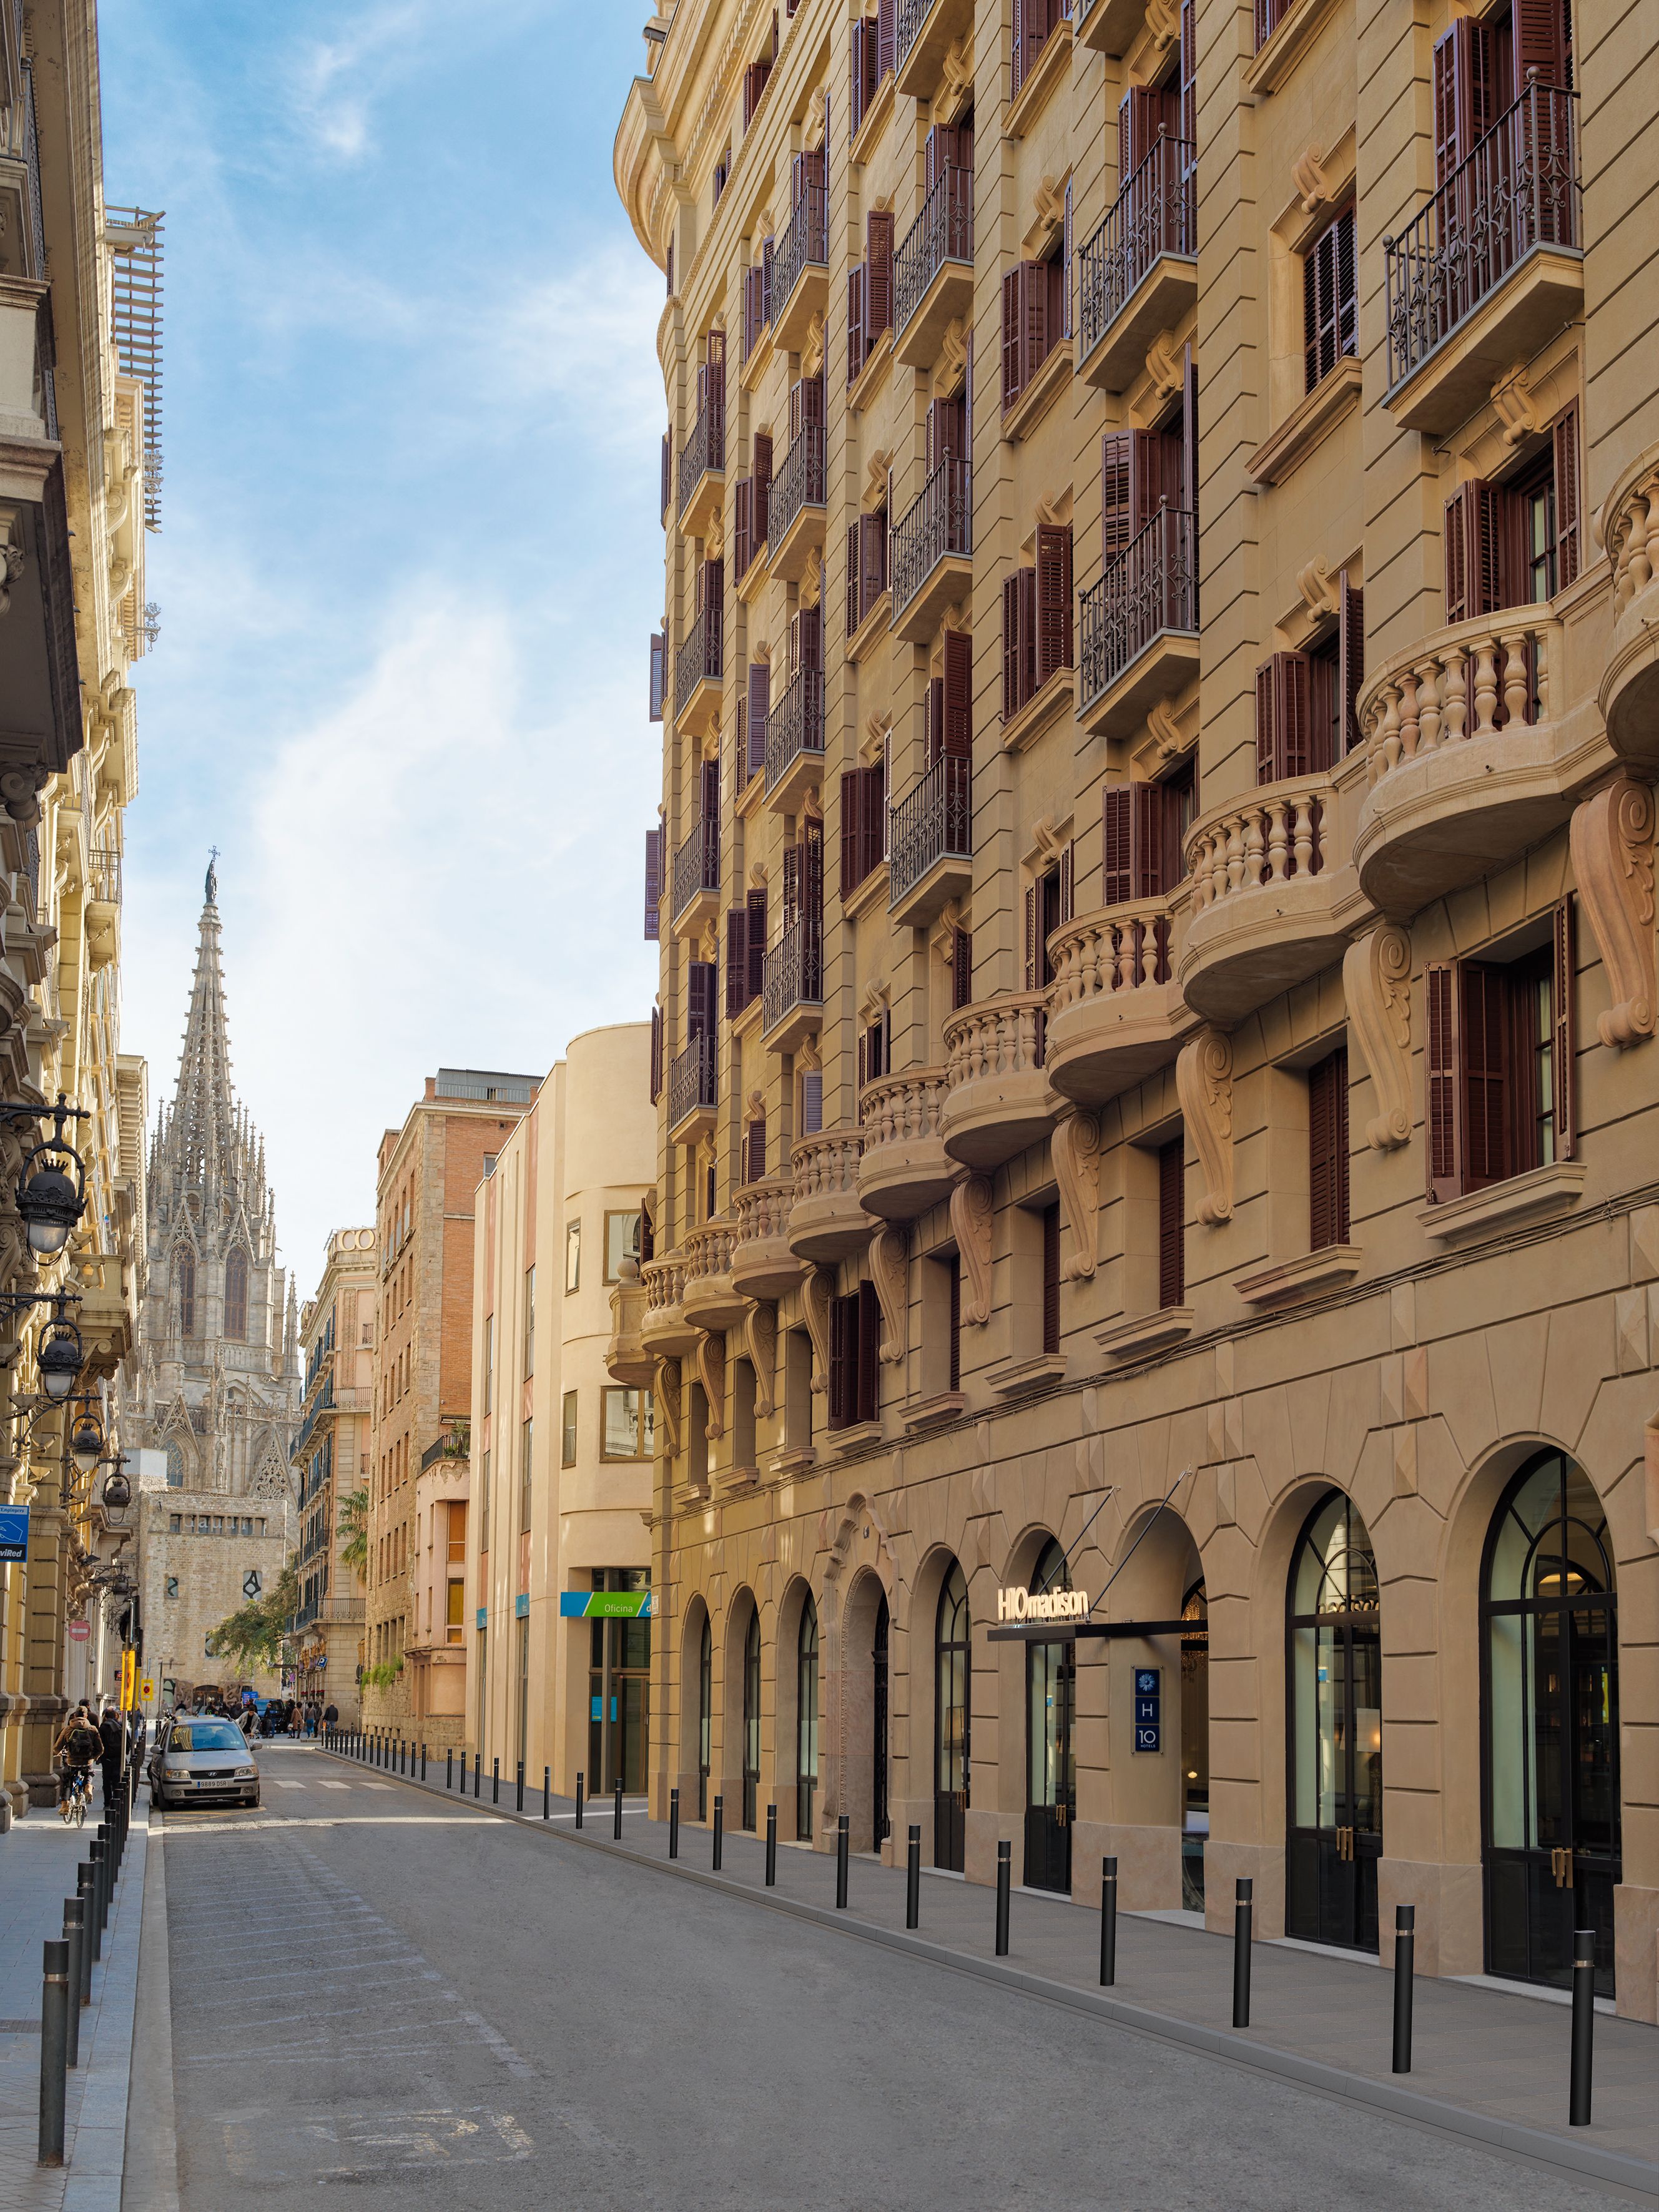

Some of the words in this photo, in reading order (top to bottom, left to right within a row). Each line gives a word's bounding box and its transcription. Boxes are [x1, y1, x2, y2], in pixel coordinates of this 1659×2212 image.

[604, 1604, 633, 1613] Oficina
[318, 1658, 325, 1666] P
[1139, 1730, 1156, 1744] 10
